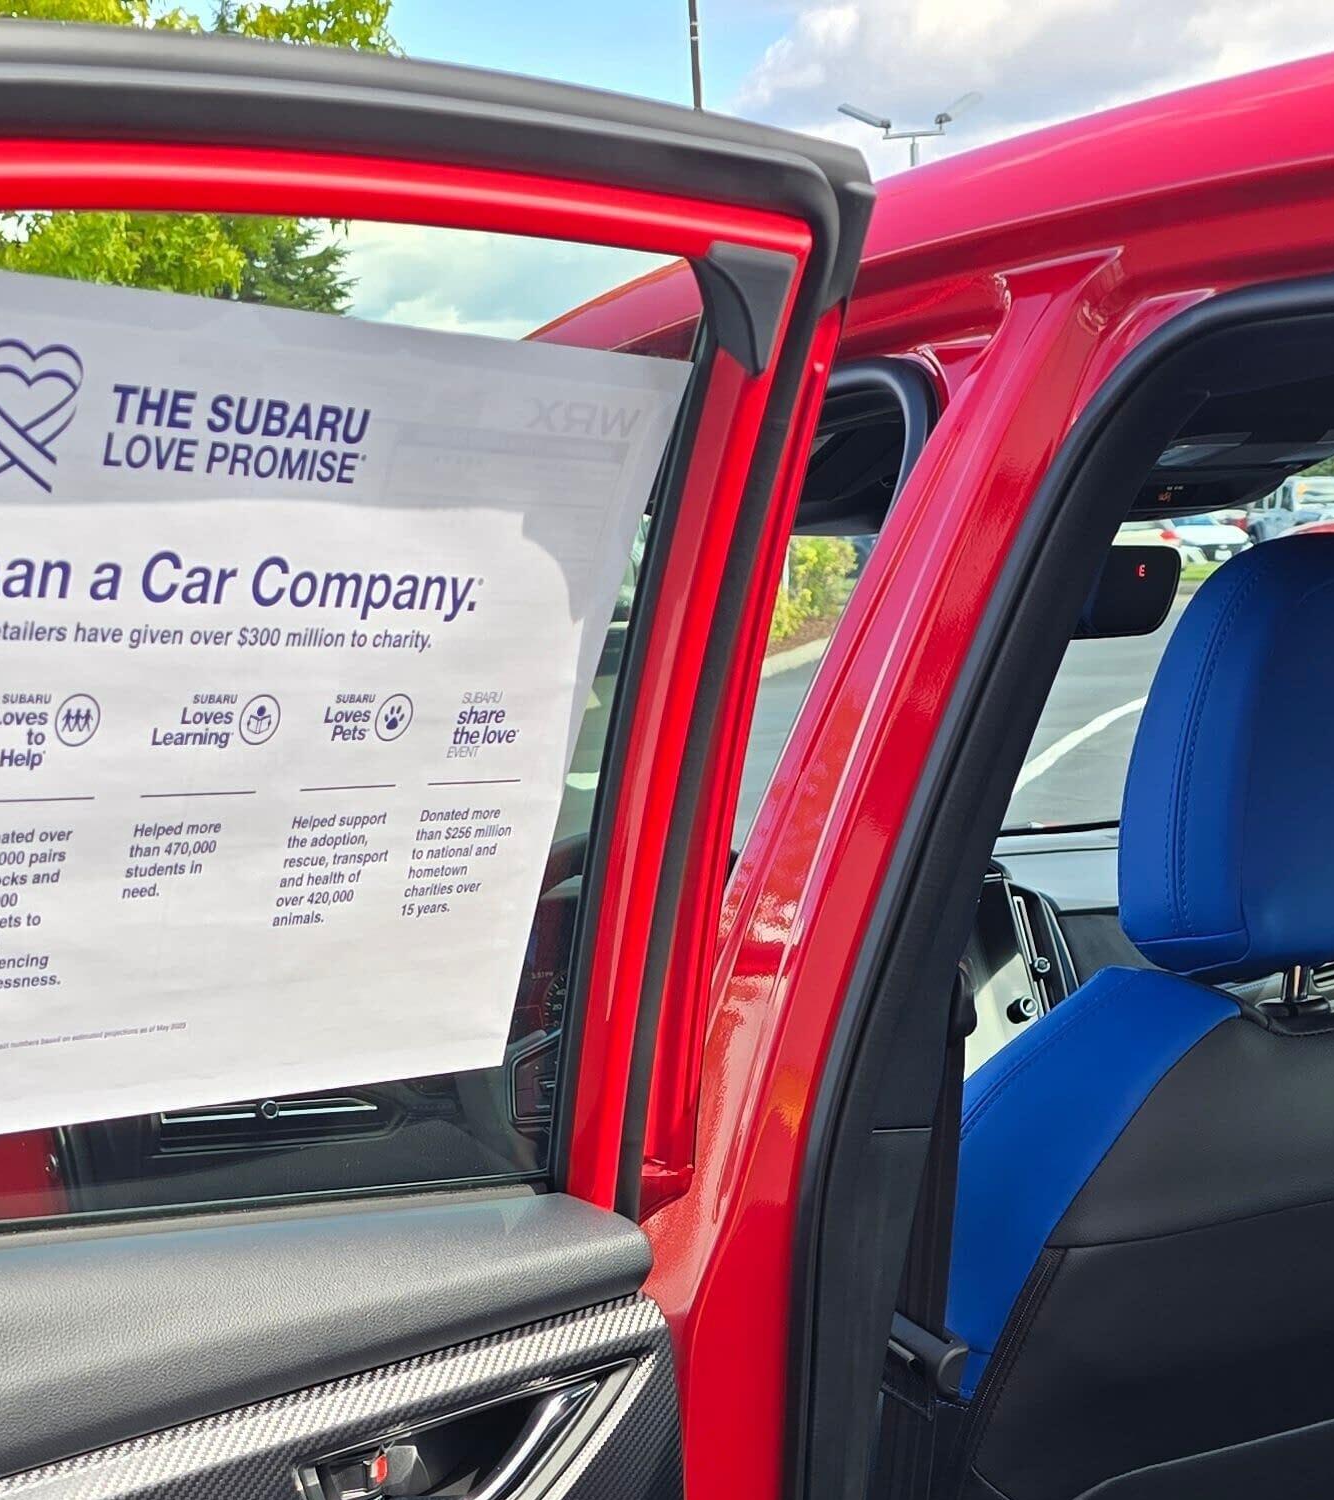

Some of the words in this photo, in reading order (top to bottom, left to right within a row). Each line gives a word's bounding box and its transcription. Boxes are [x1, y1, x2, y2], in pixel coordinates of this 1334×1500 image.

[113, 384, 197, 430] THE
[206, 394, 371, 445] SUBARU
[103, 431, 199, 472] LOVE
[205, 441, 359, 484] PROMISE
[89, 562, 122, 601] a
[141, 550, 238, 605] Car
[73, 622, 124, 644] have
[128, 623, 184, 649] given
[189, 630, 233, 646] over
[237, 626, 281, 648] $300
[285, 627, 346, 648] million
[350, 629, 368, 648] to
[372, 629, 432, 652] charity.
[1, 693, 52, 705] SUBARU
[192, 693, 238, 705] SUBARU
[335, 693, 376, 704] SUBARU
[461, 691, 504, 704] SUBARU
[180, 707, 234, 725] Loves
[323, 706, 372, 724] Loves
[456, 705, 506, 725] share
[26, 728, 46, 746] to
[151, 727, 231, 749] Learning
[330, 724, 370, 742] Pets
[452, 726, 480, 745] the
[481, 726, 519, 745] love
[0, 748, 46, 771] Help
[446, 745, 481, 759] EVENT
[291, 814, 337, 832] Helped
[338, 811, 388, 829] support
[419, 807, 471, 822] Donated
[471, 808, 501, 820] more
[38, 830, 74, 843] over
[133, 821, 184, 840] Helped
[186, 822, 222, 835] more
[415, 828, 442, 841] than
[444, 826, 473, 841] $256
[473, 824, 512, 838] million
[129, 844, 161, 858] than
[164, 839, 217, 857] 470,000
[287, 835, 308, 849] the
[310, 832, 368, 850] adoption,
[28, 848, 67, 868] pairs
[283, 855, 329, 869] rescue,
[332, 849, 389, 867] transport
[411, 848, 424, 860] to
[425, 844, 474, 859] national
[475, 843, 498, 857] and
[31, 869, 61, 885] and
[124, 862, 186, 879] students
[189, 860, 203, 874] in
[279, 873, 304, 888] and
[306, 871, 345, 886] health
[347, 869, 362, 883] of
[407, 864, 468, 880] hometown
[121, 882, 160, 899] need.
[275, 895, 305, 908] over
[306, 889, 355, 906] 420,000
[403, 883, 454, 898] charities
[455, 882, 482, 894] over
[272, 910, 324, 927] animals.
[401, 903, 416, 917] 15
[415, 902, 450, 918] years.
[26, 913, 42, 927] to
